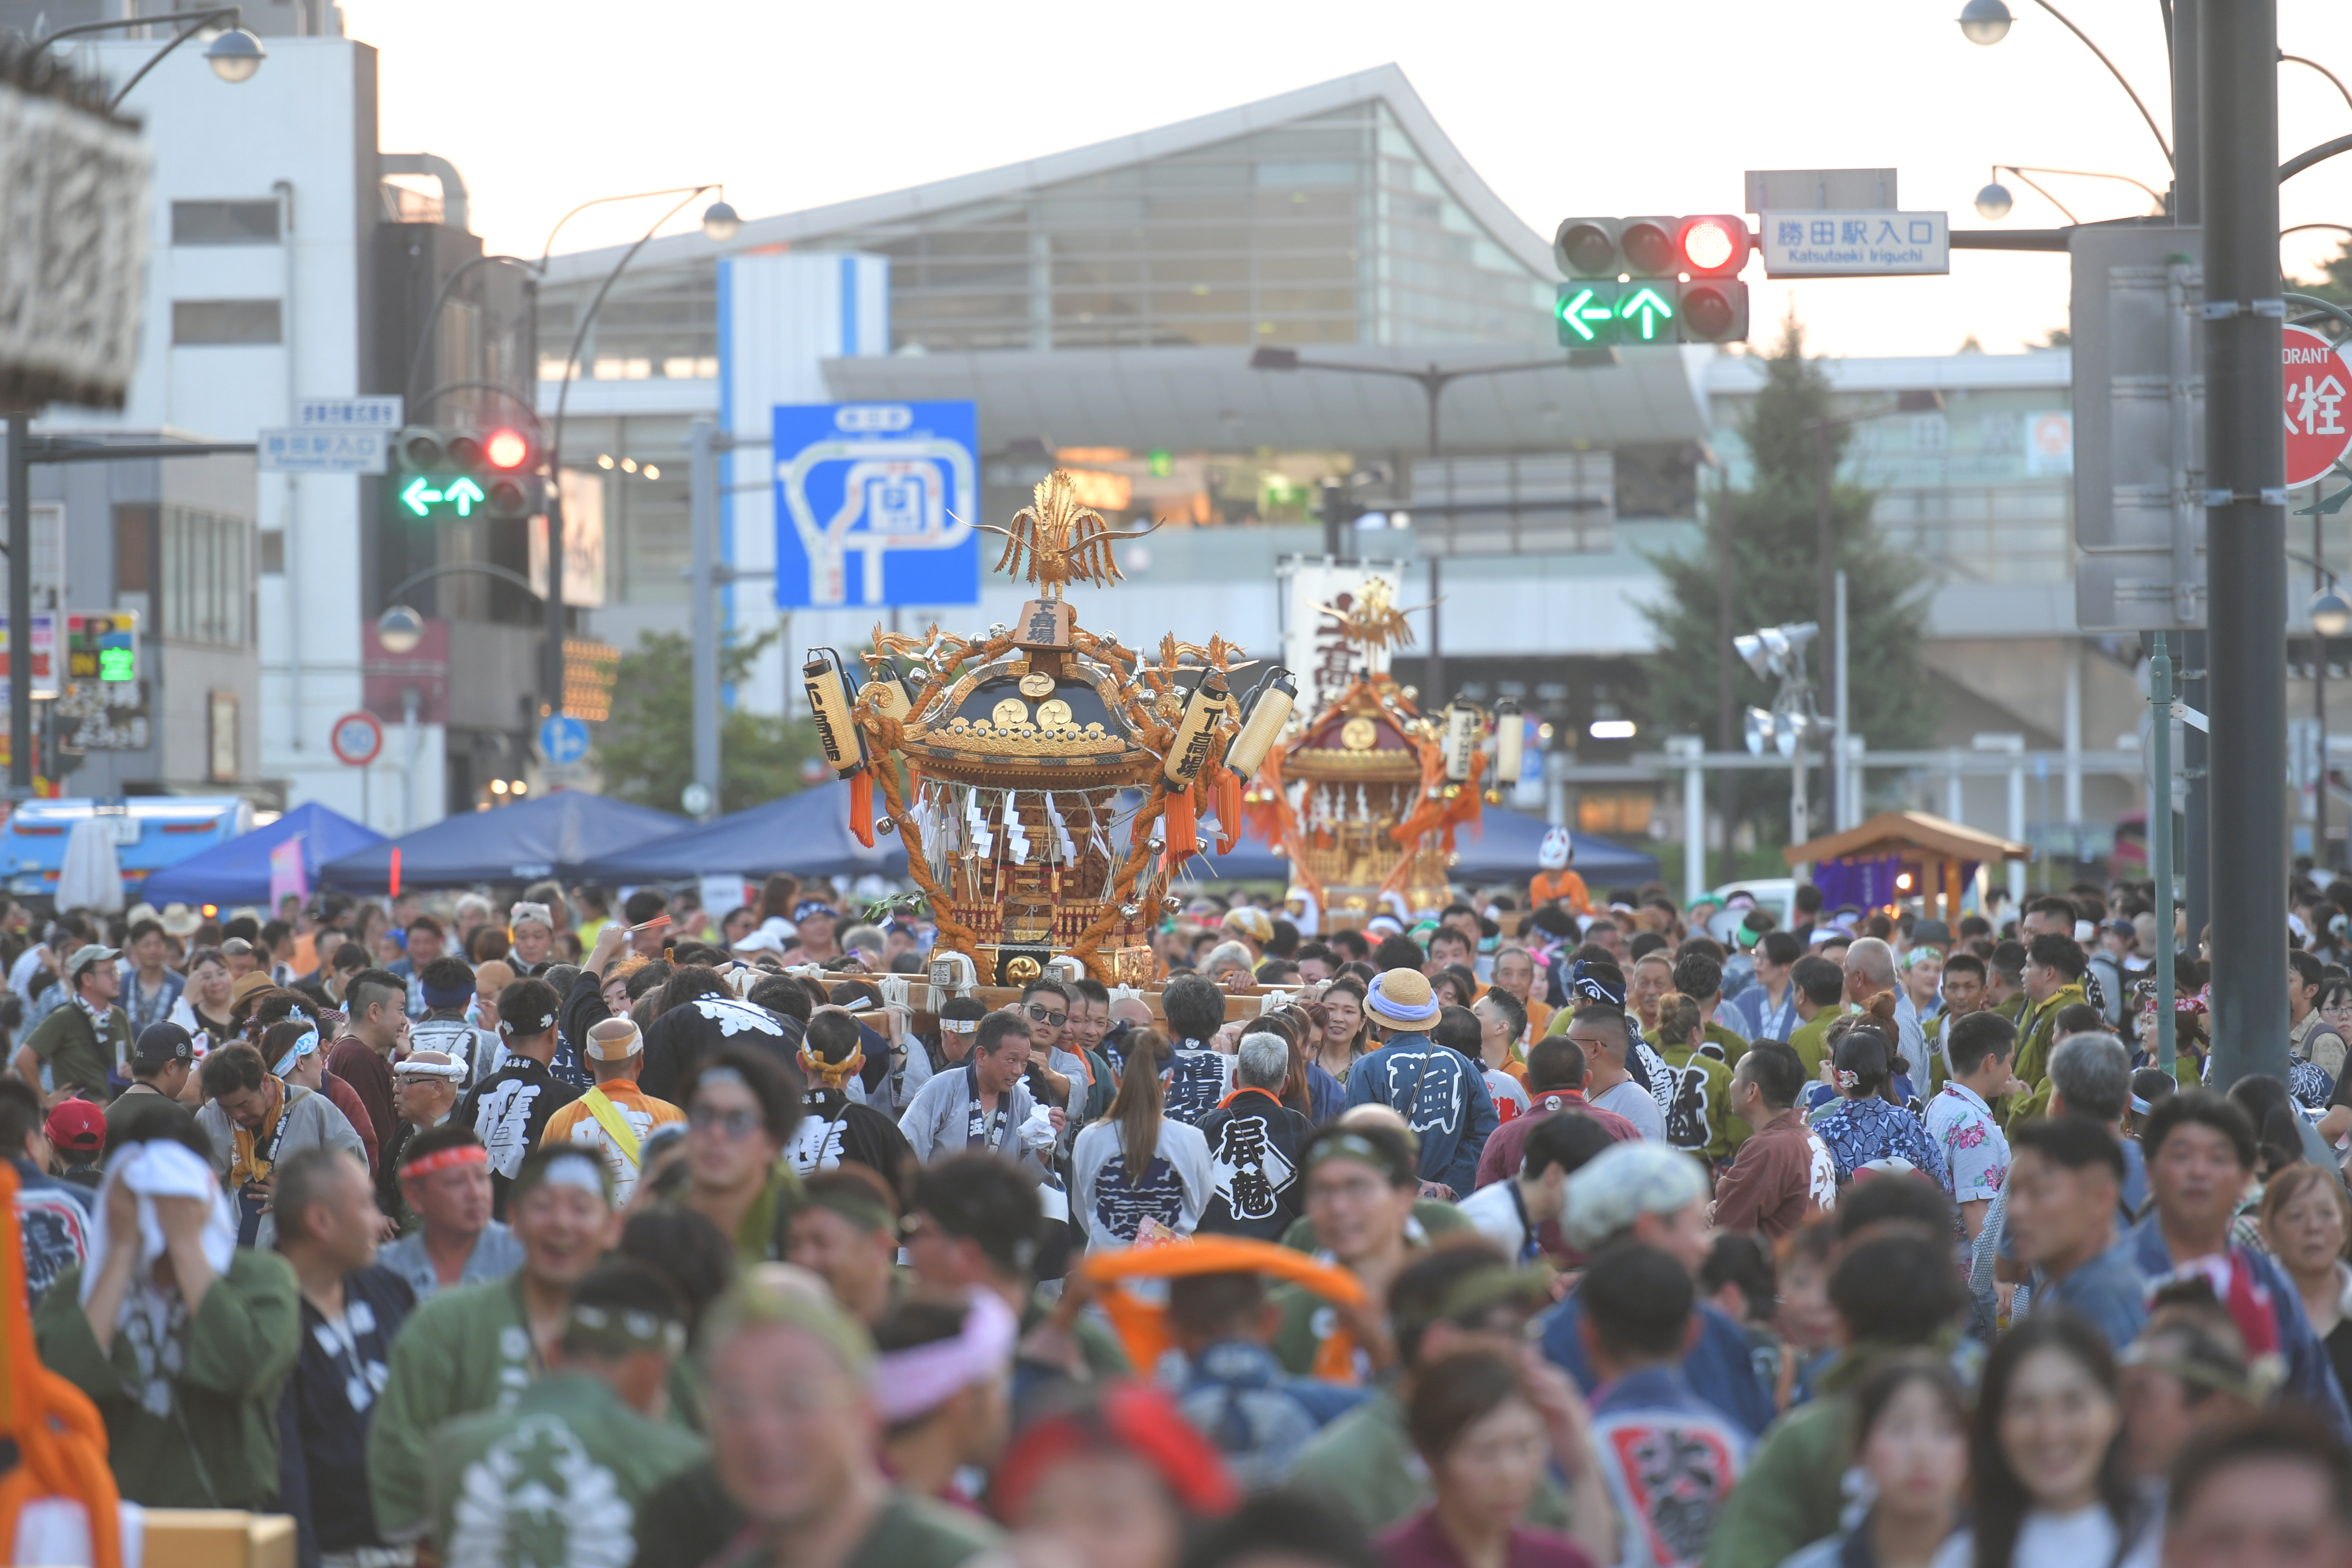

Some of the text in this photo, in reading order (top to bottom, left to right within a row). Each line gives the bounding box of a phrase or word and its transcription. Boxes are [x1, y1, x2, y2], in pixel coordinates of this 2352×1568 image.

[1778, 220, 1933, 245] 勝田駅入口
[1788, 249, 1922, 265] Katsutaeki Iriguchi
